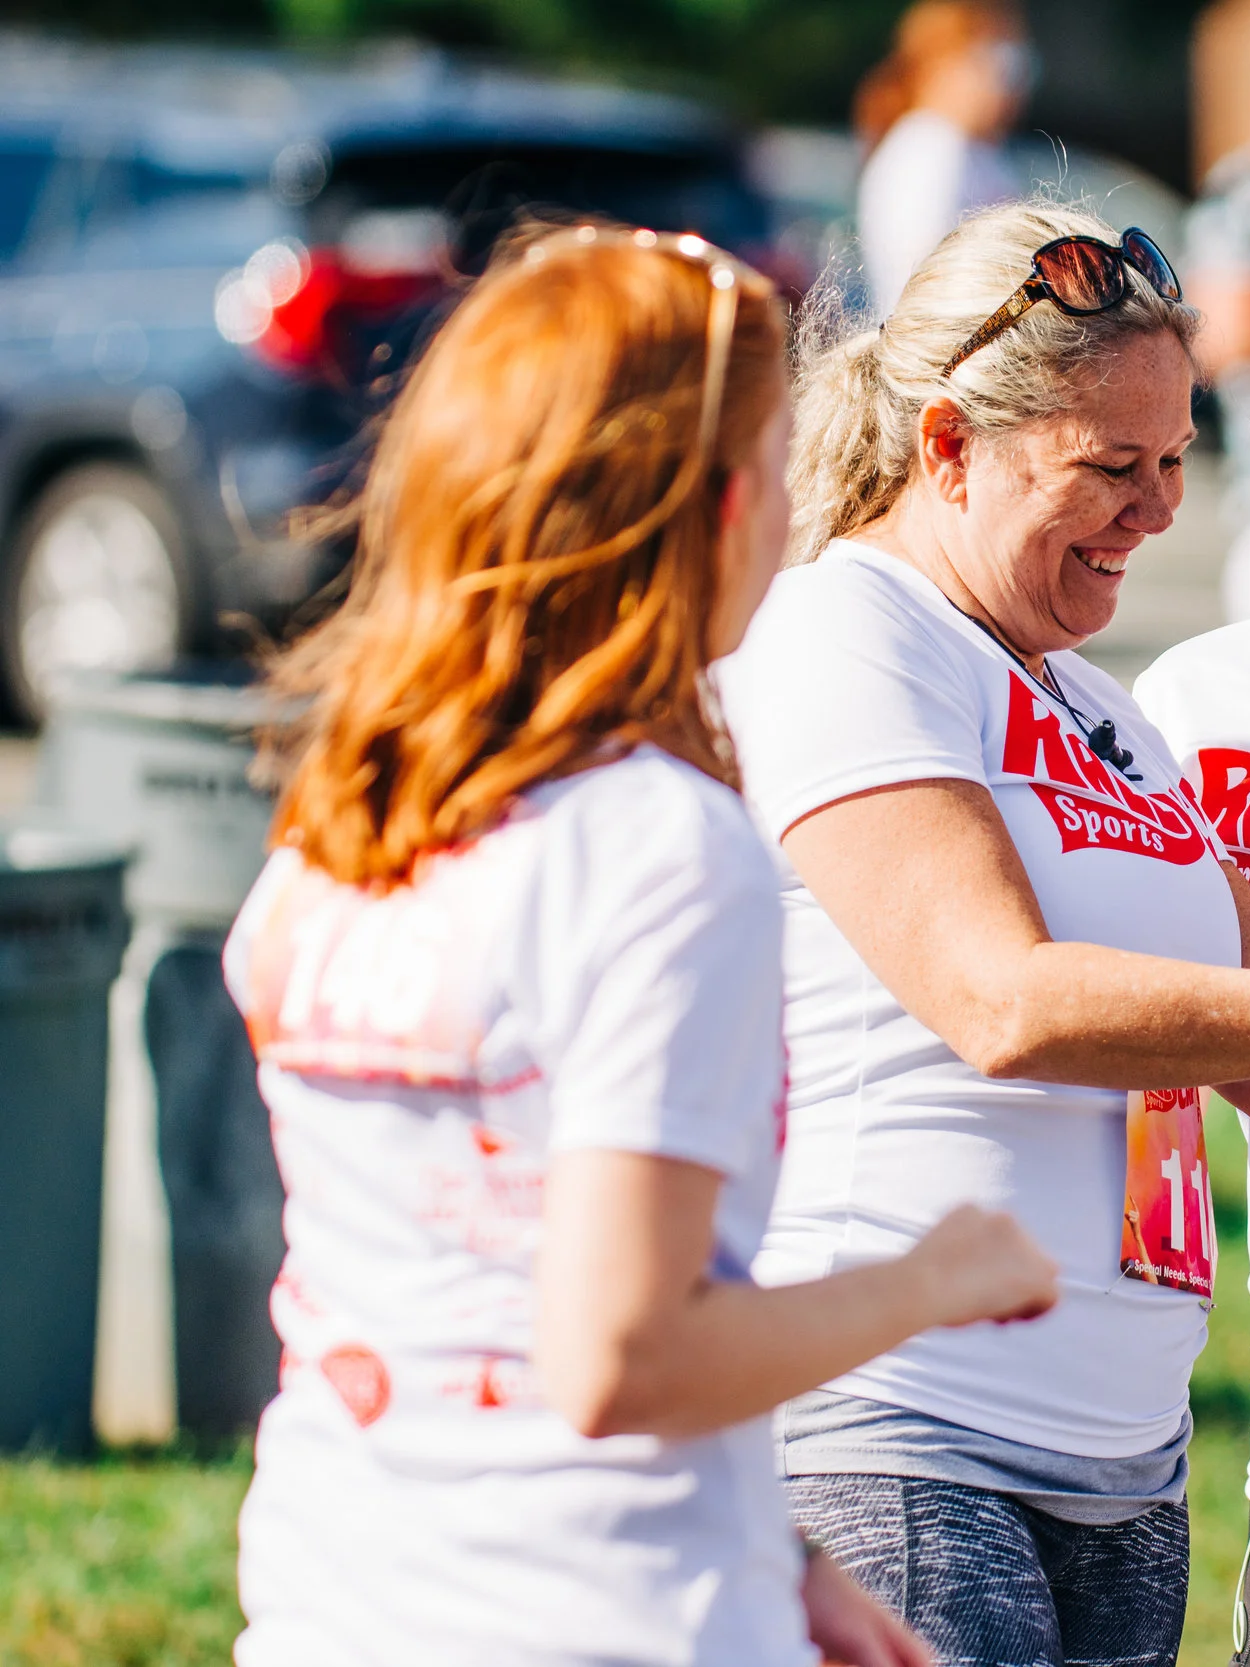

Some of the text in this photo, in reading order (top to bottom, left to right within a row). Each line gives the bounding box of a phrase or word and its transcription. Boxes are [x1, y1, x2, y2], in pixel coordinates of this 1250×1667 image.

[1055, 794, 1165, 852] Sports
[1161, 1148, 1218, 1262] 11
[1134, 1259, 1162, 1276] Special
